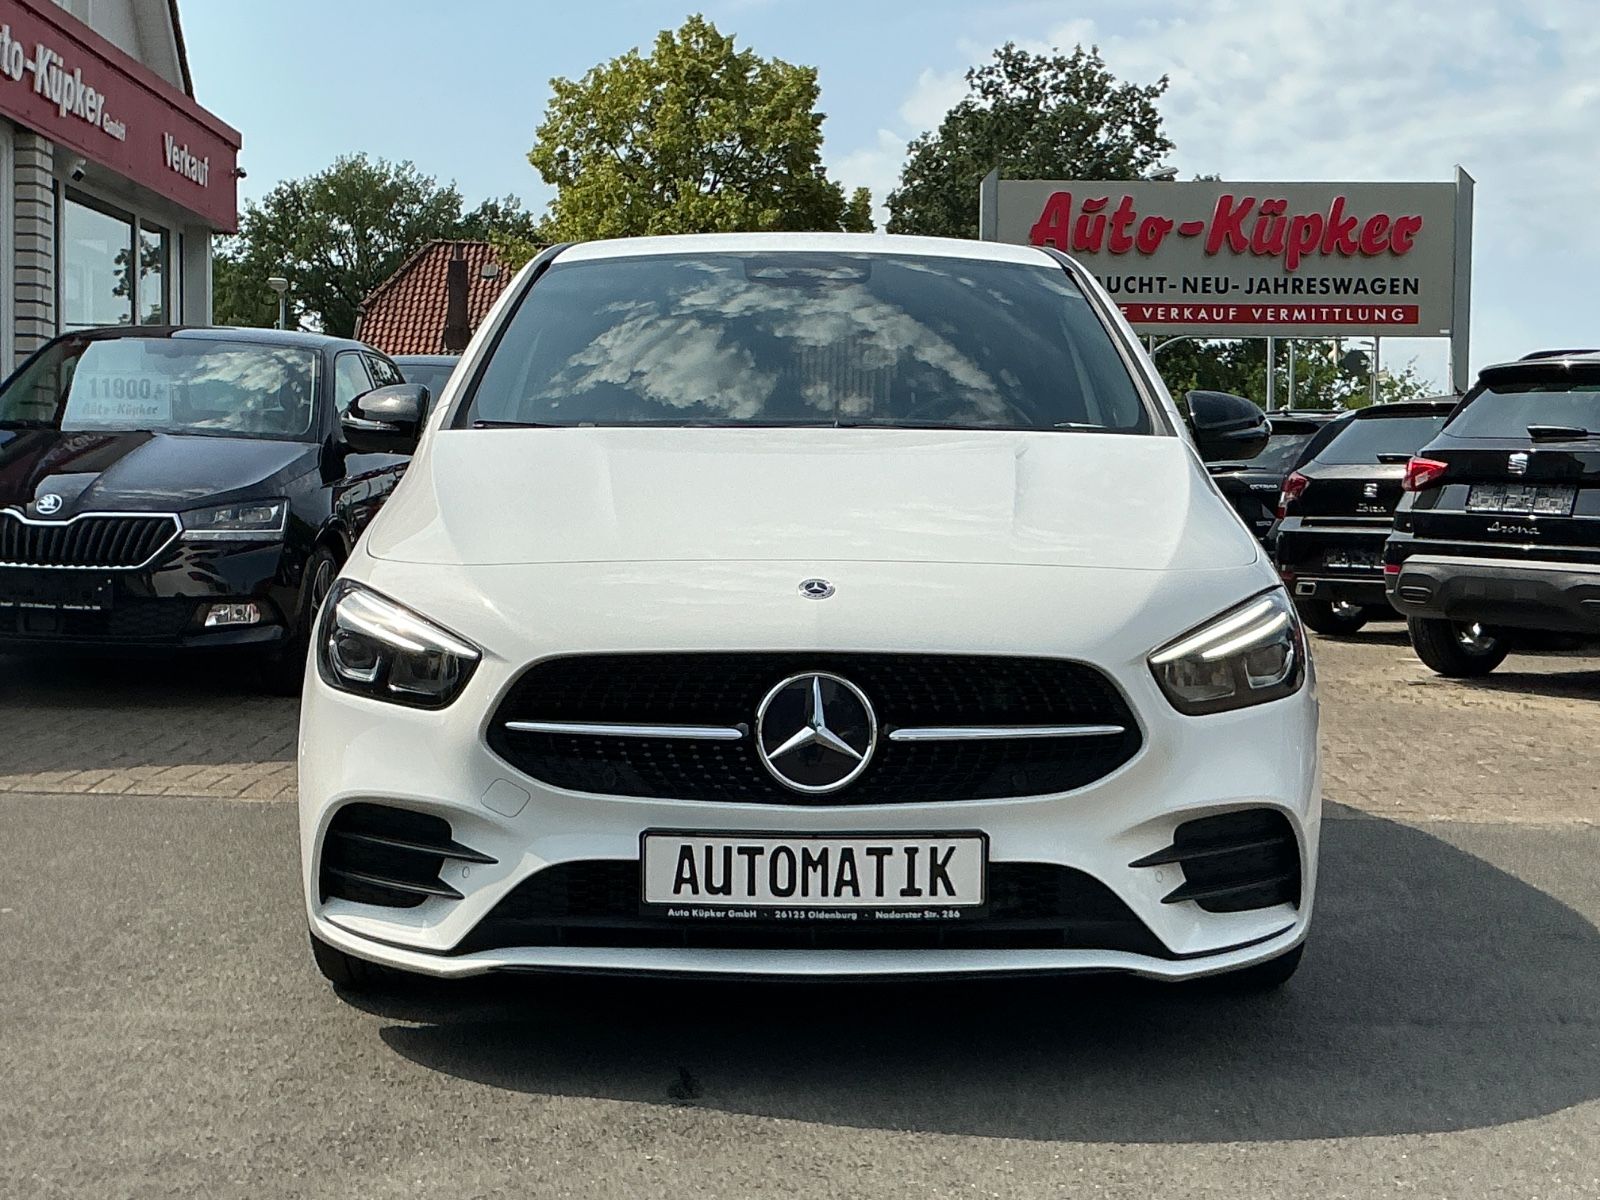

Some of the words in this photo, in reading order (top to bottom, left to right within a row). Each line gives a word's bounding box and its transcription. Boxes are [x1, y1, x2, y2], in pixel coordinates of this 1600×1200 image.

[163, 131, 209, 188] Verkauf
[1142, 307, 1238, 320] VERKAUF
[1252, 308, 1405, 321] VERMITTLUNG
[1486, 521, 1541, 535] Arona
[672, 844, 957, 898] AUTOMATIK
[667, 908, 690, 917] Auto
[692, 908, 726, 919] Küpker
[728, 909, 757, 918] GmbH
[808, 910, 857, 920] Oldenburg
[924, 910, 940, 918] Str.
[942, 910, 960, 918] 286
